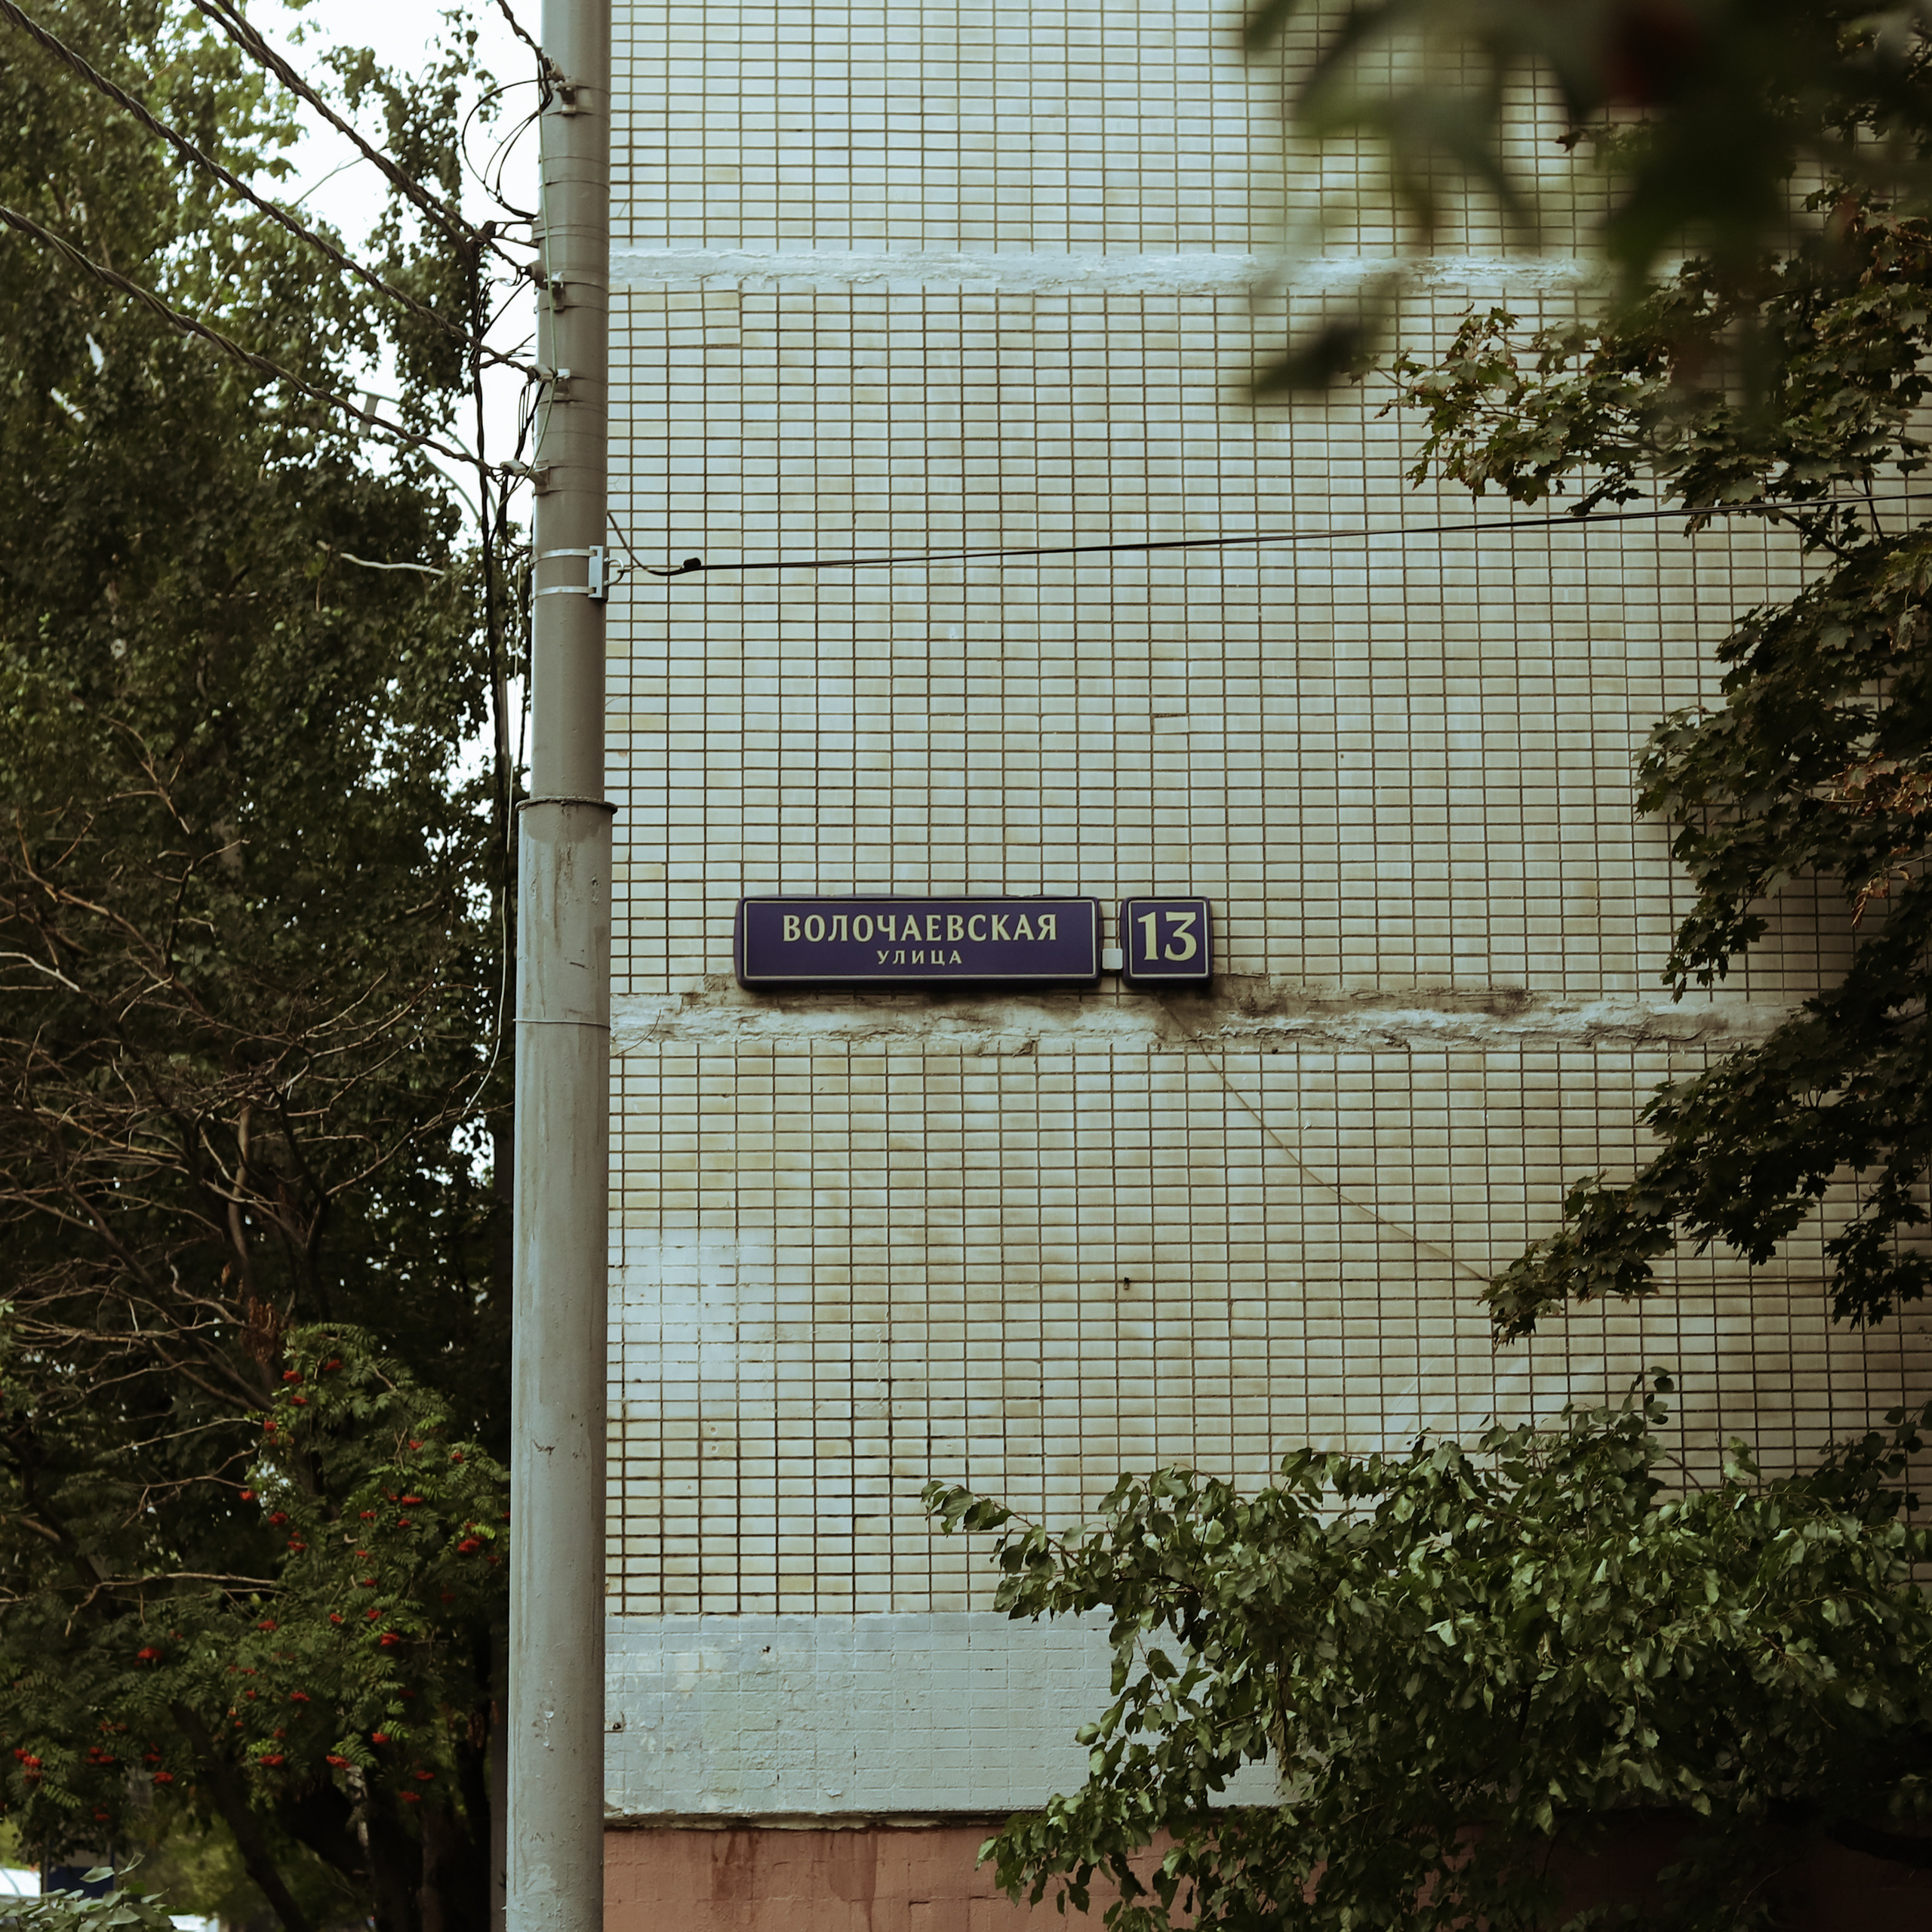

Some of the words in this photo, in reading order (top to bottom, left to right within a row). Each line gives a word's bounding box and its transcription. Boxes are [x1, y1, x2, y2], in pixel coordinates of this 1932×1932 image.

[783, 914, 1057, 943] ВОЛОЧАЕВСКАЯ
[1137, 911, 1198, 962] 13
[876, 949, 963, 966] УЛИЦА
